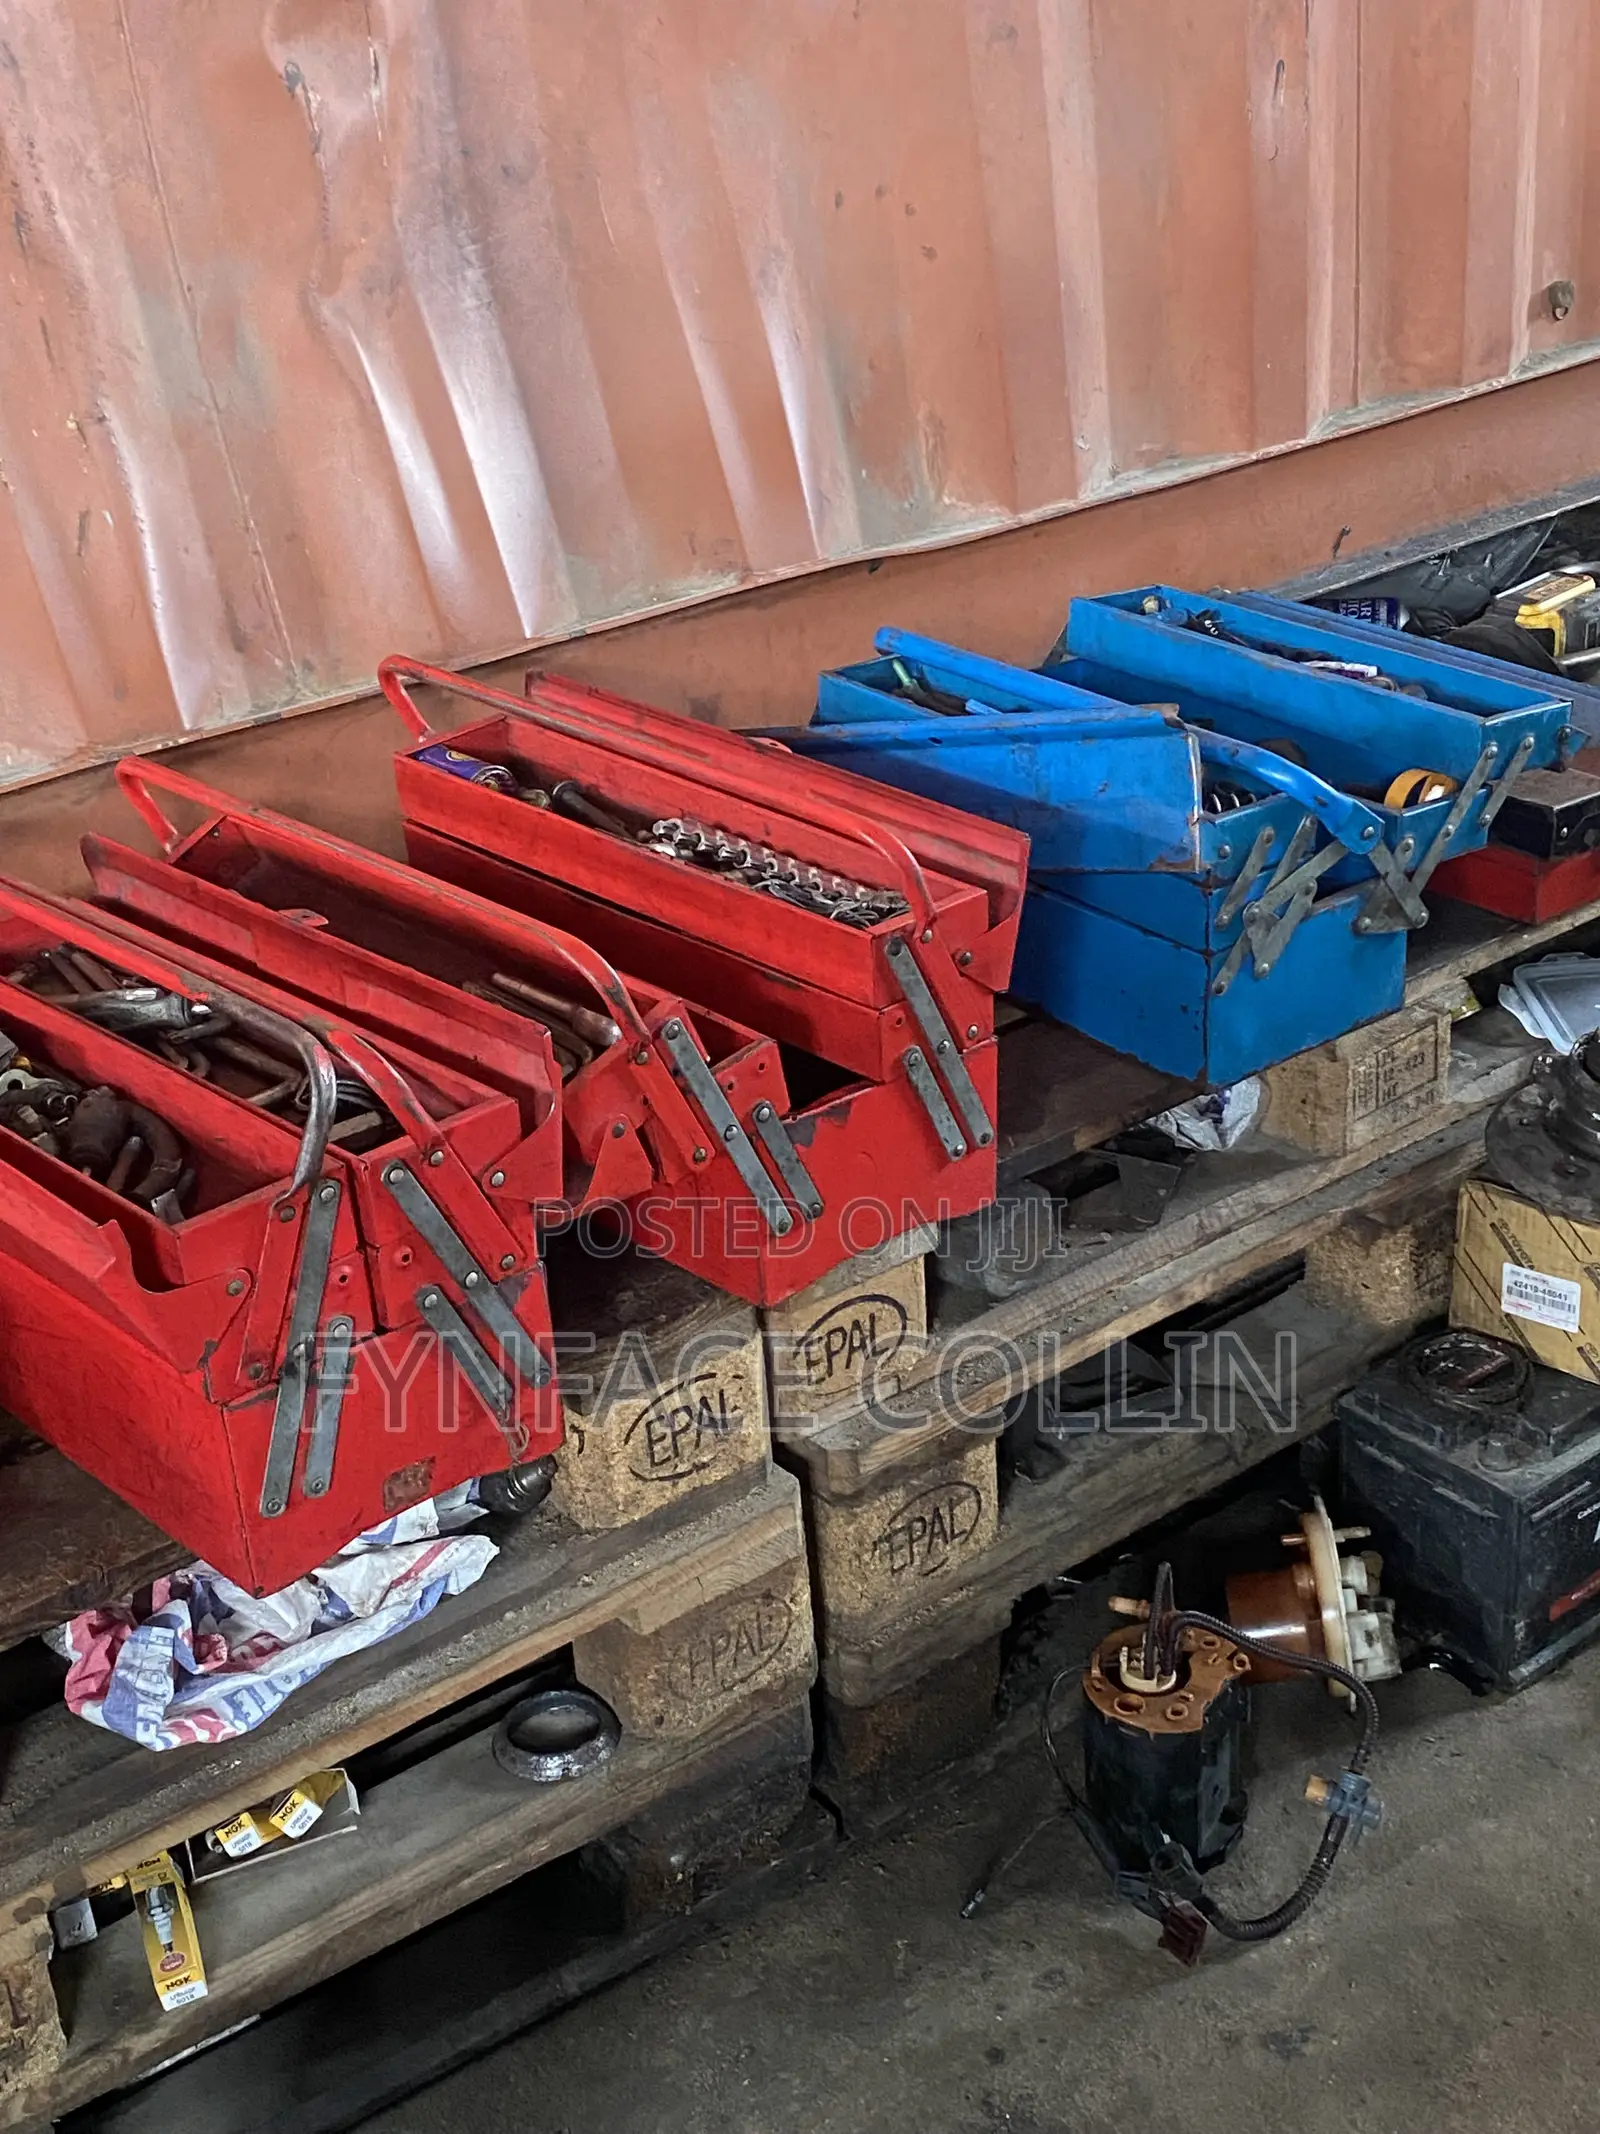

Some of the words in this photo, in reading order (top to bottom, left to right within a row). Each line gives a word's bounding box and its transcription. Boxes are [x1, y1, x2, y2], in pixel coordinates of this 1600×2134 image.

[803, 1312, 890, 1386] EPAL
[645, 1388, 743, 1469] EPAL
[886, 1504, 969, 1576] EPAL
[279, 1798, 300, 1822] NGK
[224, 1819, 246, 1838] NGK
[136, 1857, 161, 1870] NGK
[165, 1971, 193, 1990] NGK
